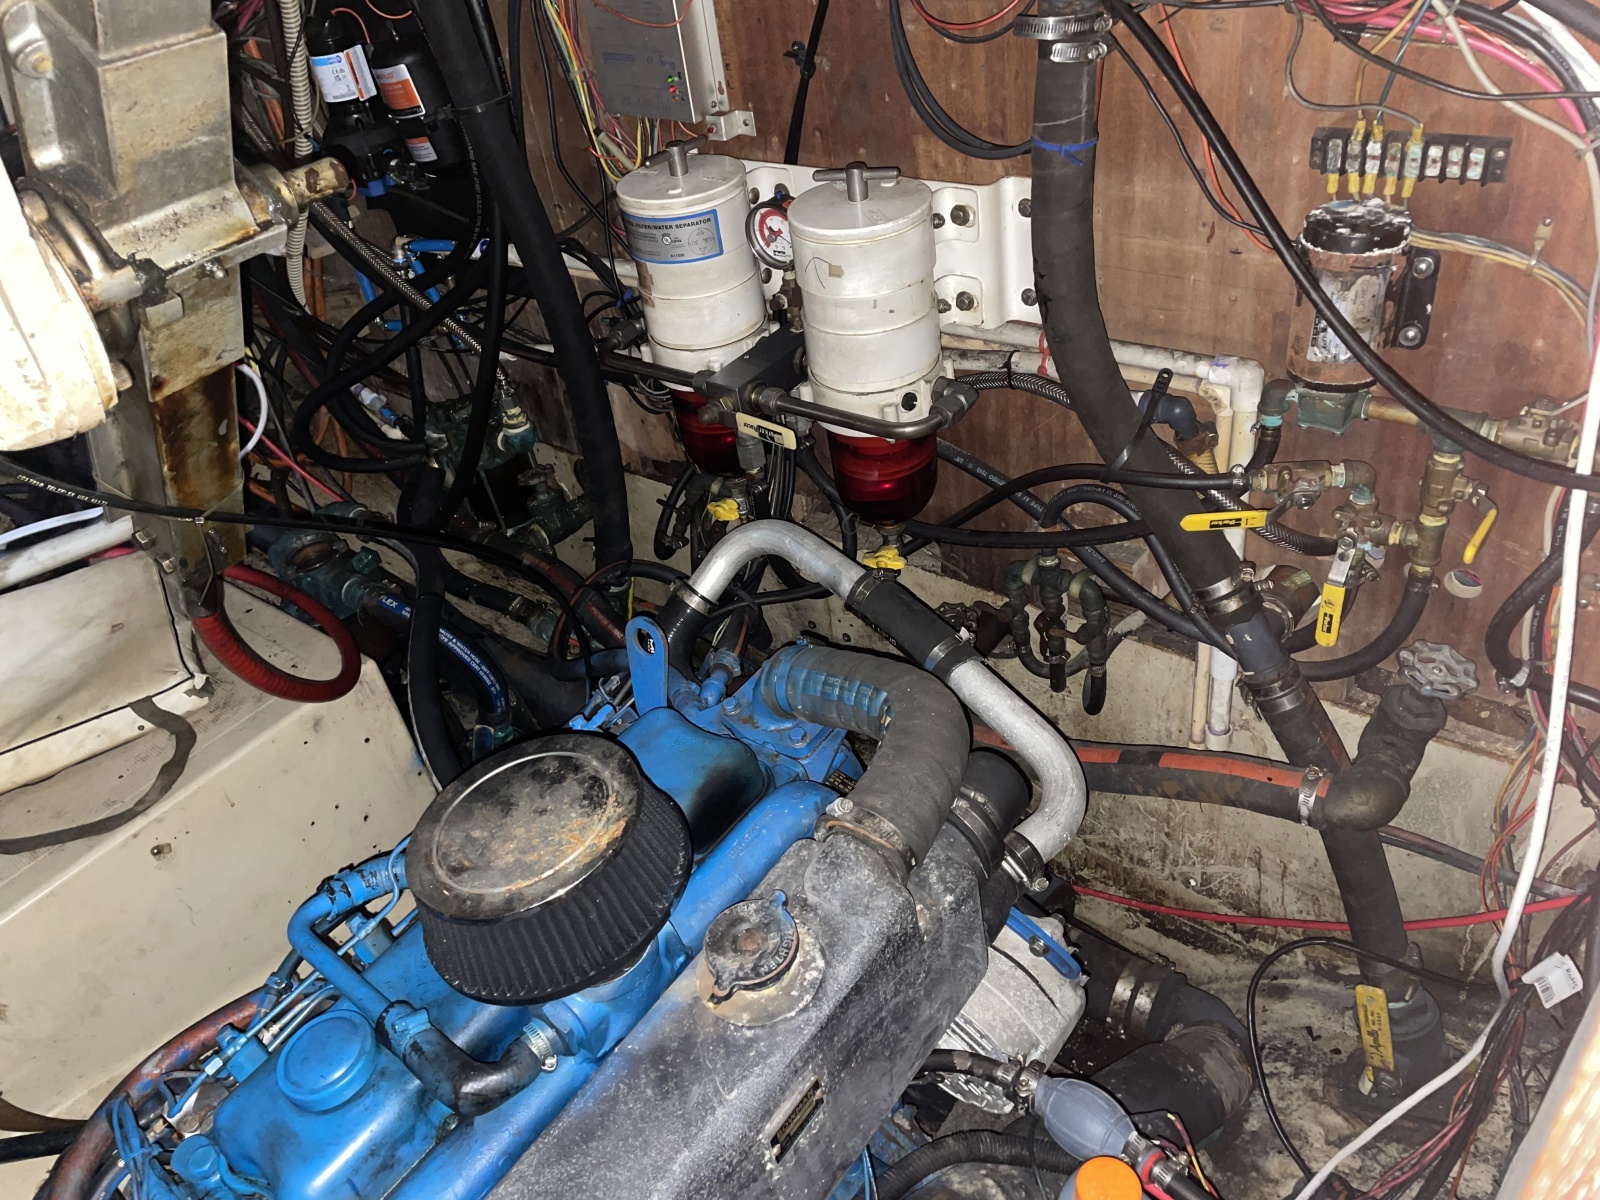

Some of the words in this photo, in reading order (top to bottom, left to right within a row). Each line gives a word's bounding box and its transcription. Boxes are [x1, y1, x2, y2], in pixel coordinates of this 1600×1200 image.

[635, 221, 674, 231] FILTER/WATER
[675, 217, 712, 230] SEPARATOR
[46, 484, 76, 497] TELEFEX
[1029, 499, 1044, 513] TYPE
[448, 641, 472, 662] APPROVED
[456, 641, 472, 656] WATER
[469, 651, 481, 665] HOSE
[776, 1088, 814, 1140] BOWMAN
